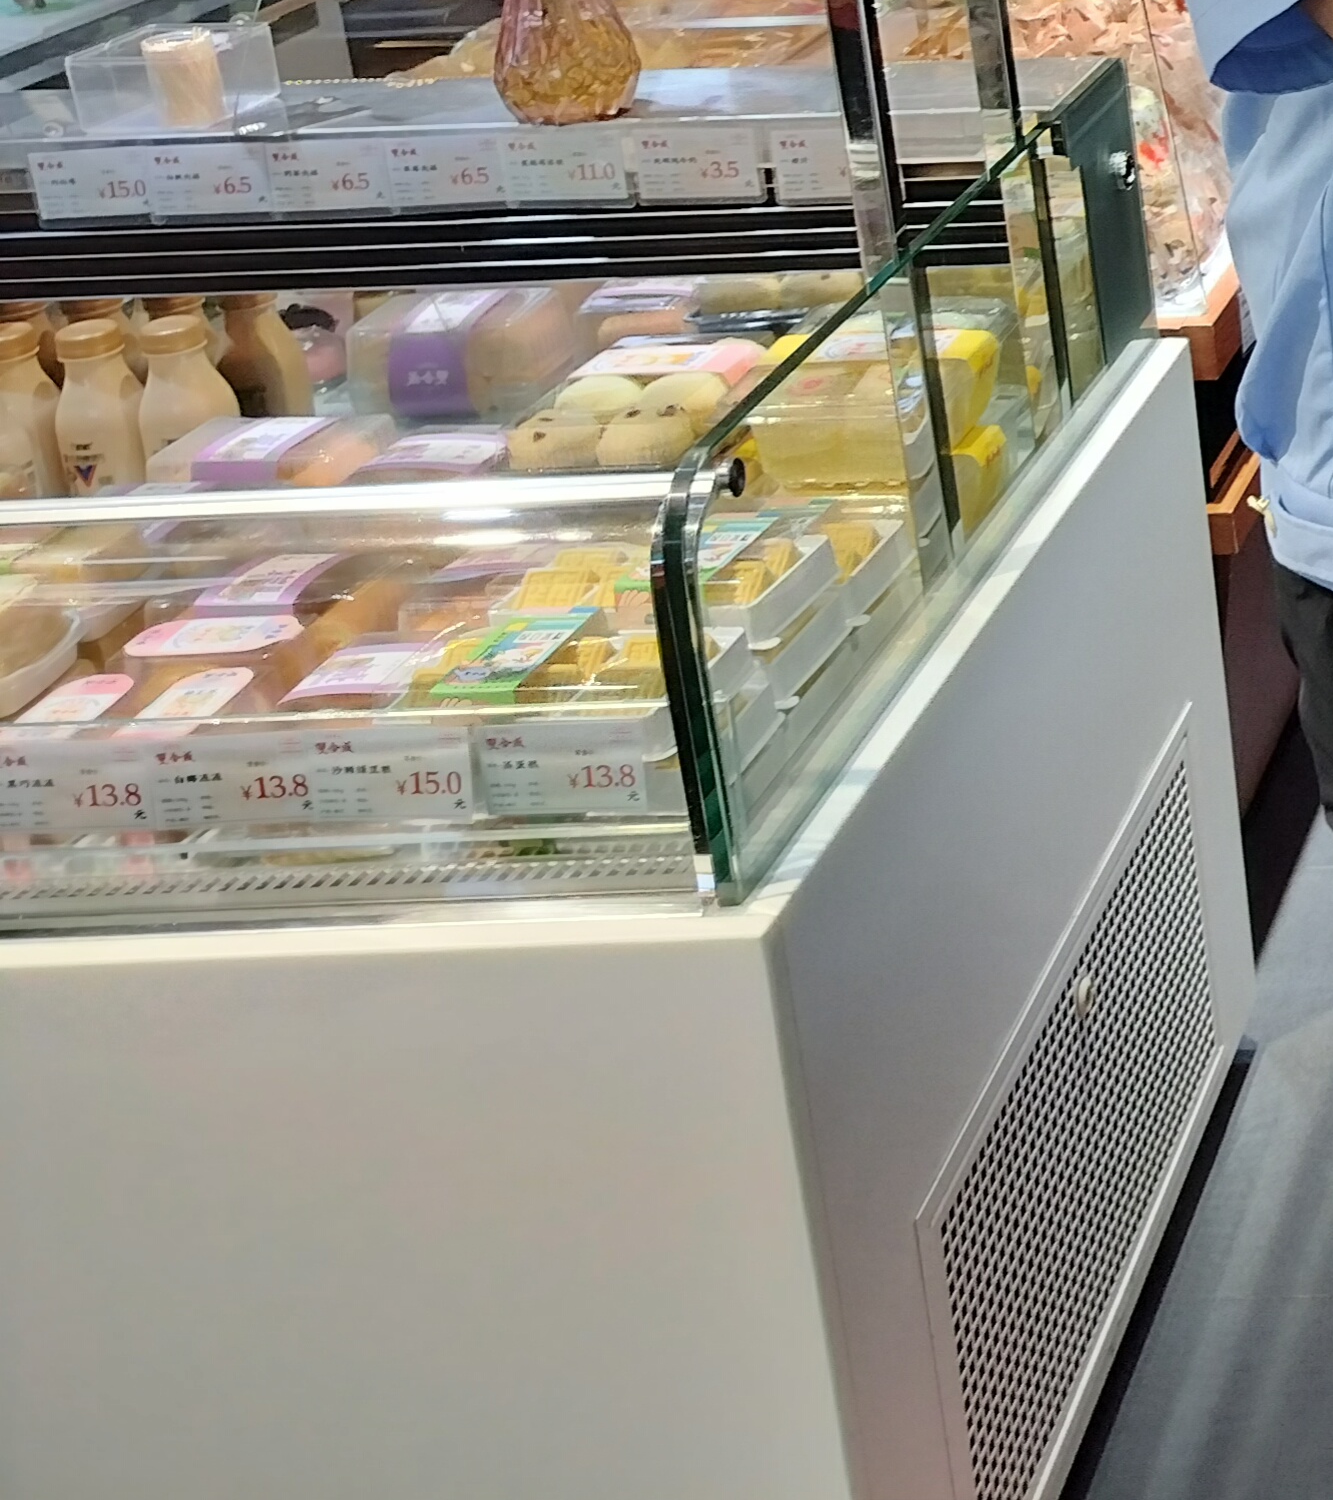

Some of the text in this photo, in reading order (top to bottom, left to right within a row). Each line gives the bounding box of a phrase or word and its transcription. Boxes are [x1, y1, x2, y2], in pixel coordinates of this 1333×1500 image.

[240, 774, 309, 800] ¥13.8
[396, 771, 462, 796] ¥15.0
[567, 764, 636, 790] ¥13.8
[73, 783, 142, 807] ¥13.8
